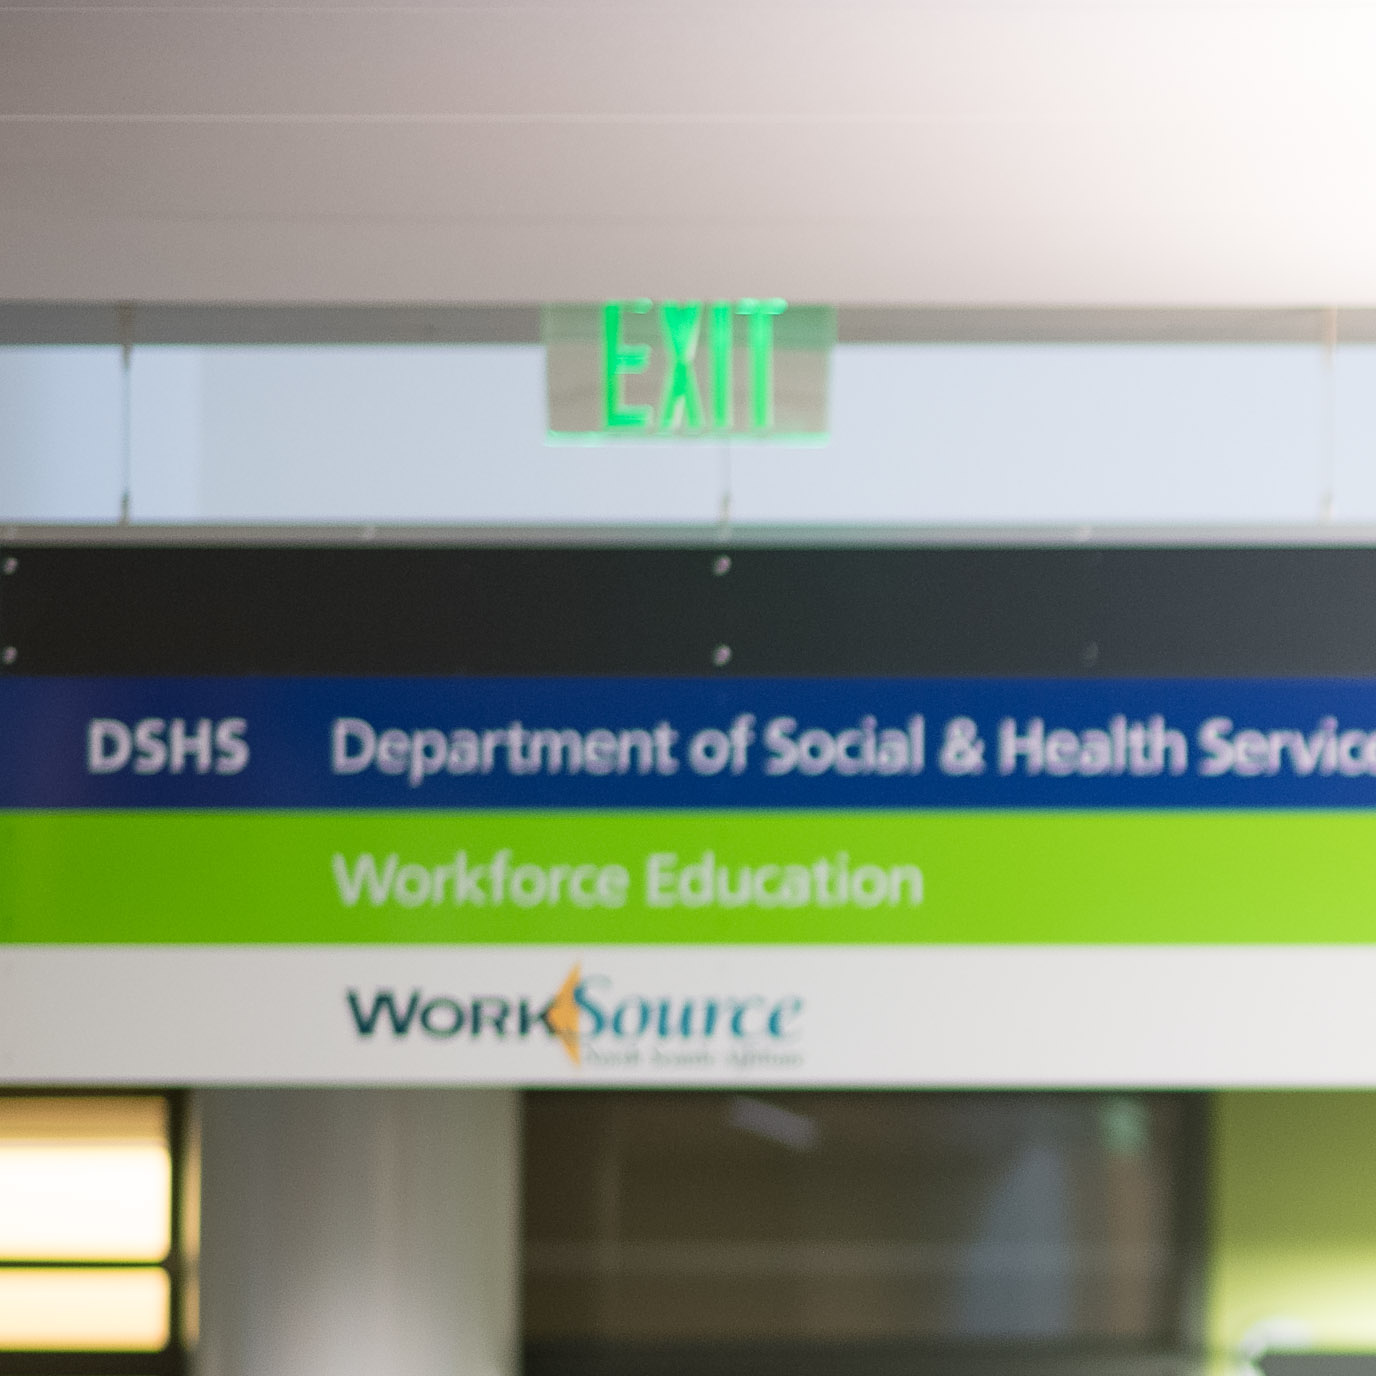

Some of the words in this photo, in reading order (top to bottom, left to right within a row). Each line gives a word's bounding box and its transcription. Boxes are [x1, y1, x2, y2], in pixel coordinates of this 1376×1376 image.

[603, 298, 788, 428] EXIT
[87, 717, 250, 775] DSHS
[332, 716, 680, 787] Department
[688, 713, 756, 775] of
[763, 714, 924, 776] Social
[938, 716, 985, 776] &
[999, 714, 1188, 776] Health
[332, 848, 630, 908] Workforce
[647, 849, 923, 908] Education
